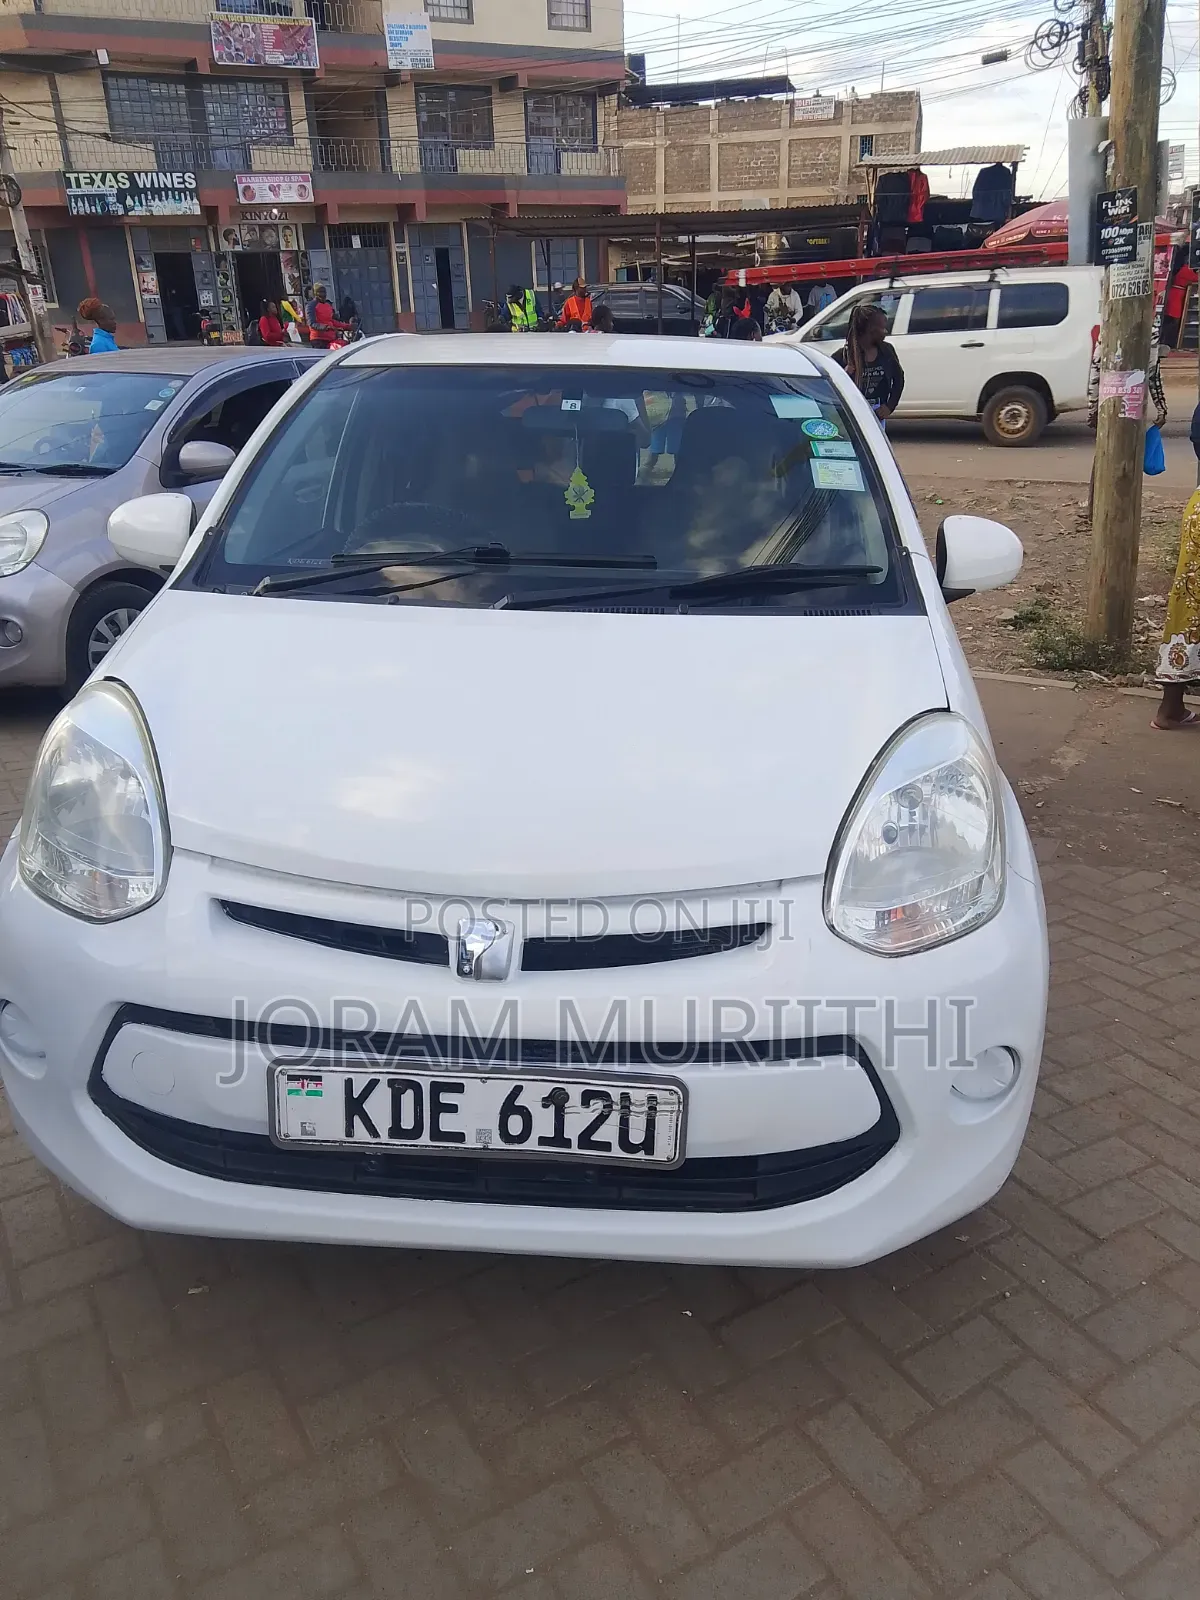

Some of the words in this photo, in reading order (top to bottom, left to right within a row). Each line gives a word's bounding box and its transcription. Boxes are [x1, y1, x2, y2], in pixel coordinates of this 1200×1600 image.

[66, 172, 130, 189] TEXAS
[134, 172, 197, 189] WINES
[1102, 198, 1133, 209] FLINK
[240, 211, 289, 220] KINYOZI
[1100, 226, 1120, 240] 100
[1114, 236, 1126, 246] 2K
[1111, 282, 1127, 299] 0722
[1128, 281, 1141, 296] 626
[344, 1077, 467, 1143] KDE
[498, 1084, 660, 1156] 612U
